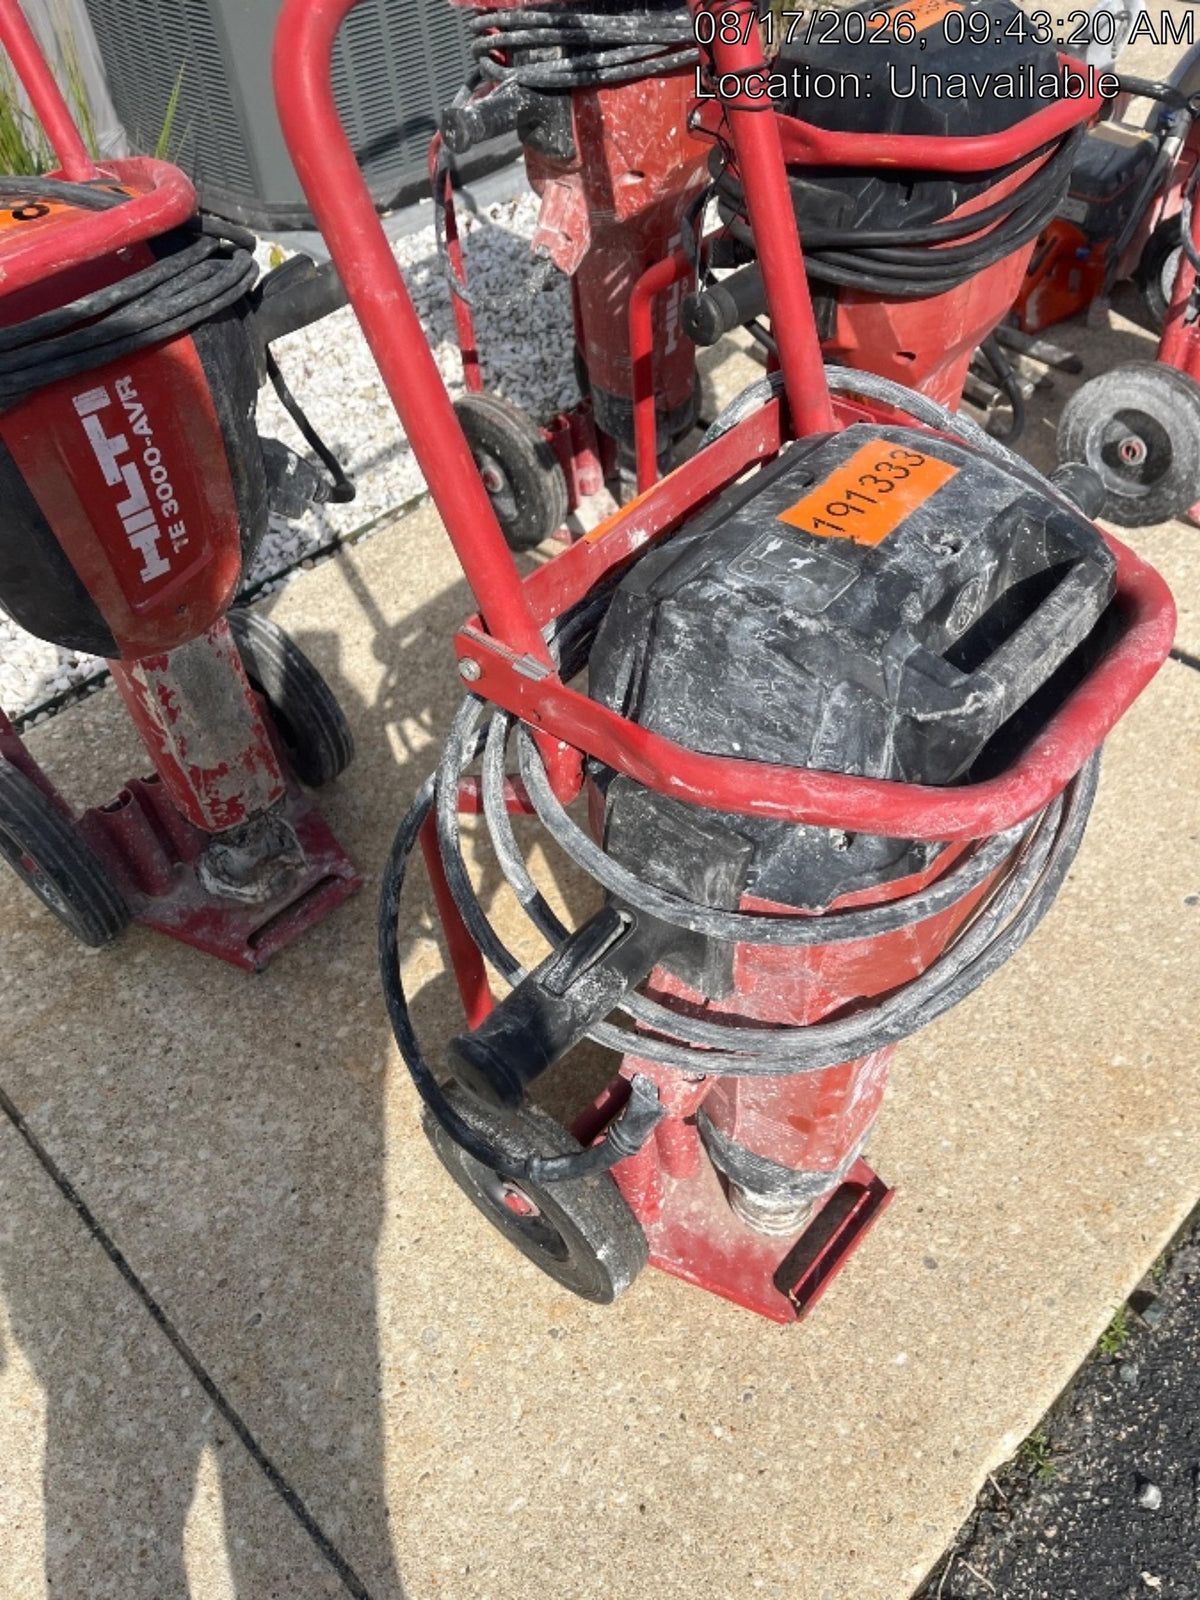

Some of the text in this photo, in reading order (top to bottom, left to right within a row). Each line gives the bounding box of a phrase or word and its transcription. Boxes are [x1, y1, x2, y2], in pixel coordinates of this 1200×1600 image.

[72, 386, 171, 584] HILTI
[115, 375, 189, 554] TE 3000-AVR
[812, 449, 926, 533] 191333
